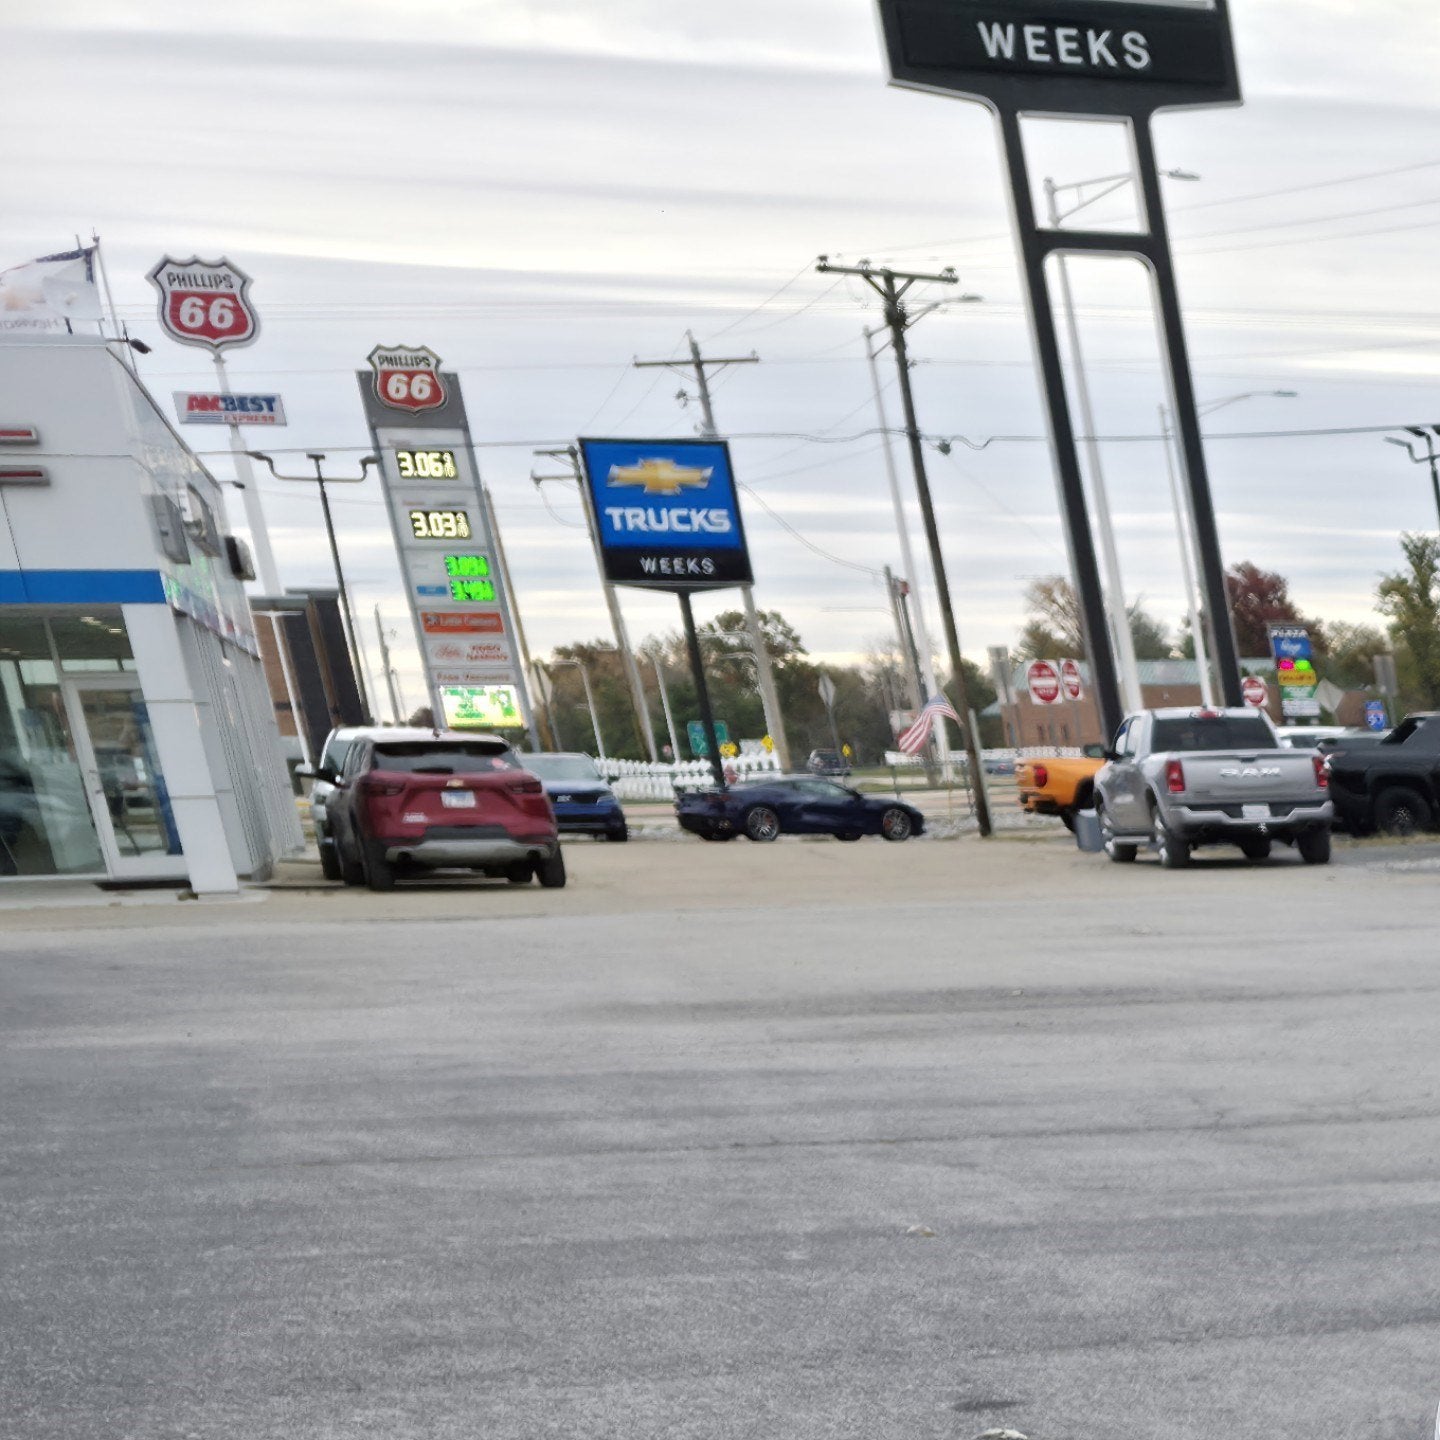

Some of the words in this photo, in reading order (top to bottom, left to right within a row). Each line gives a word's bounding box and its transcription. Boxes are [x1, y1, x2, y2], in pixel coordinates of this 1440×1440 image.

[977, 21, 1150, 69] WEEKS
[166, 271, 234, 289] PHILLIPS
[178, 296, 235, 328] 66
[377, 354, 431, 367] PHILLIPS
[387, 373, 433, 400] 66
[604, 507, 732, 533] TRUCKS
[639, 557, 716, 574] WEEKS
